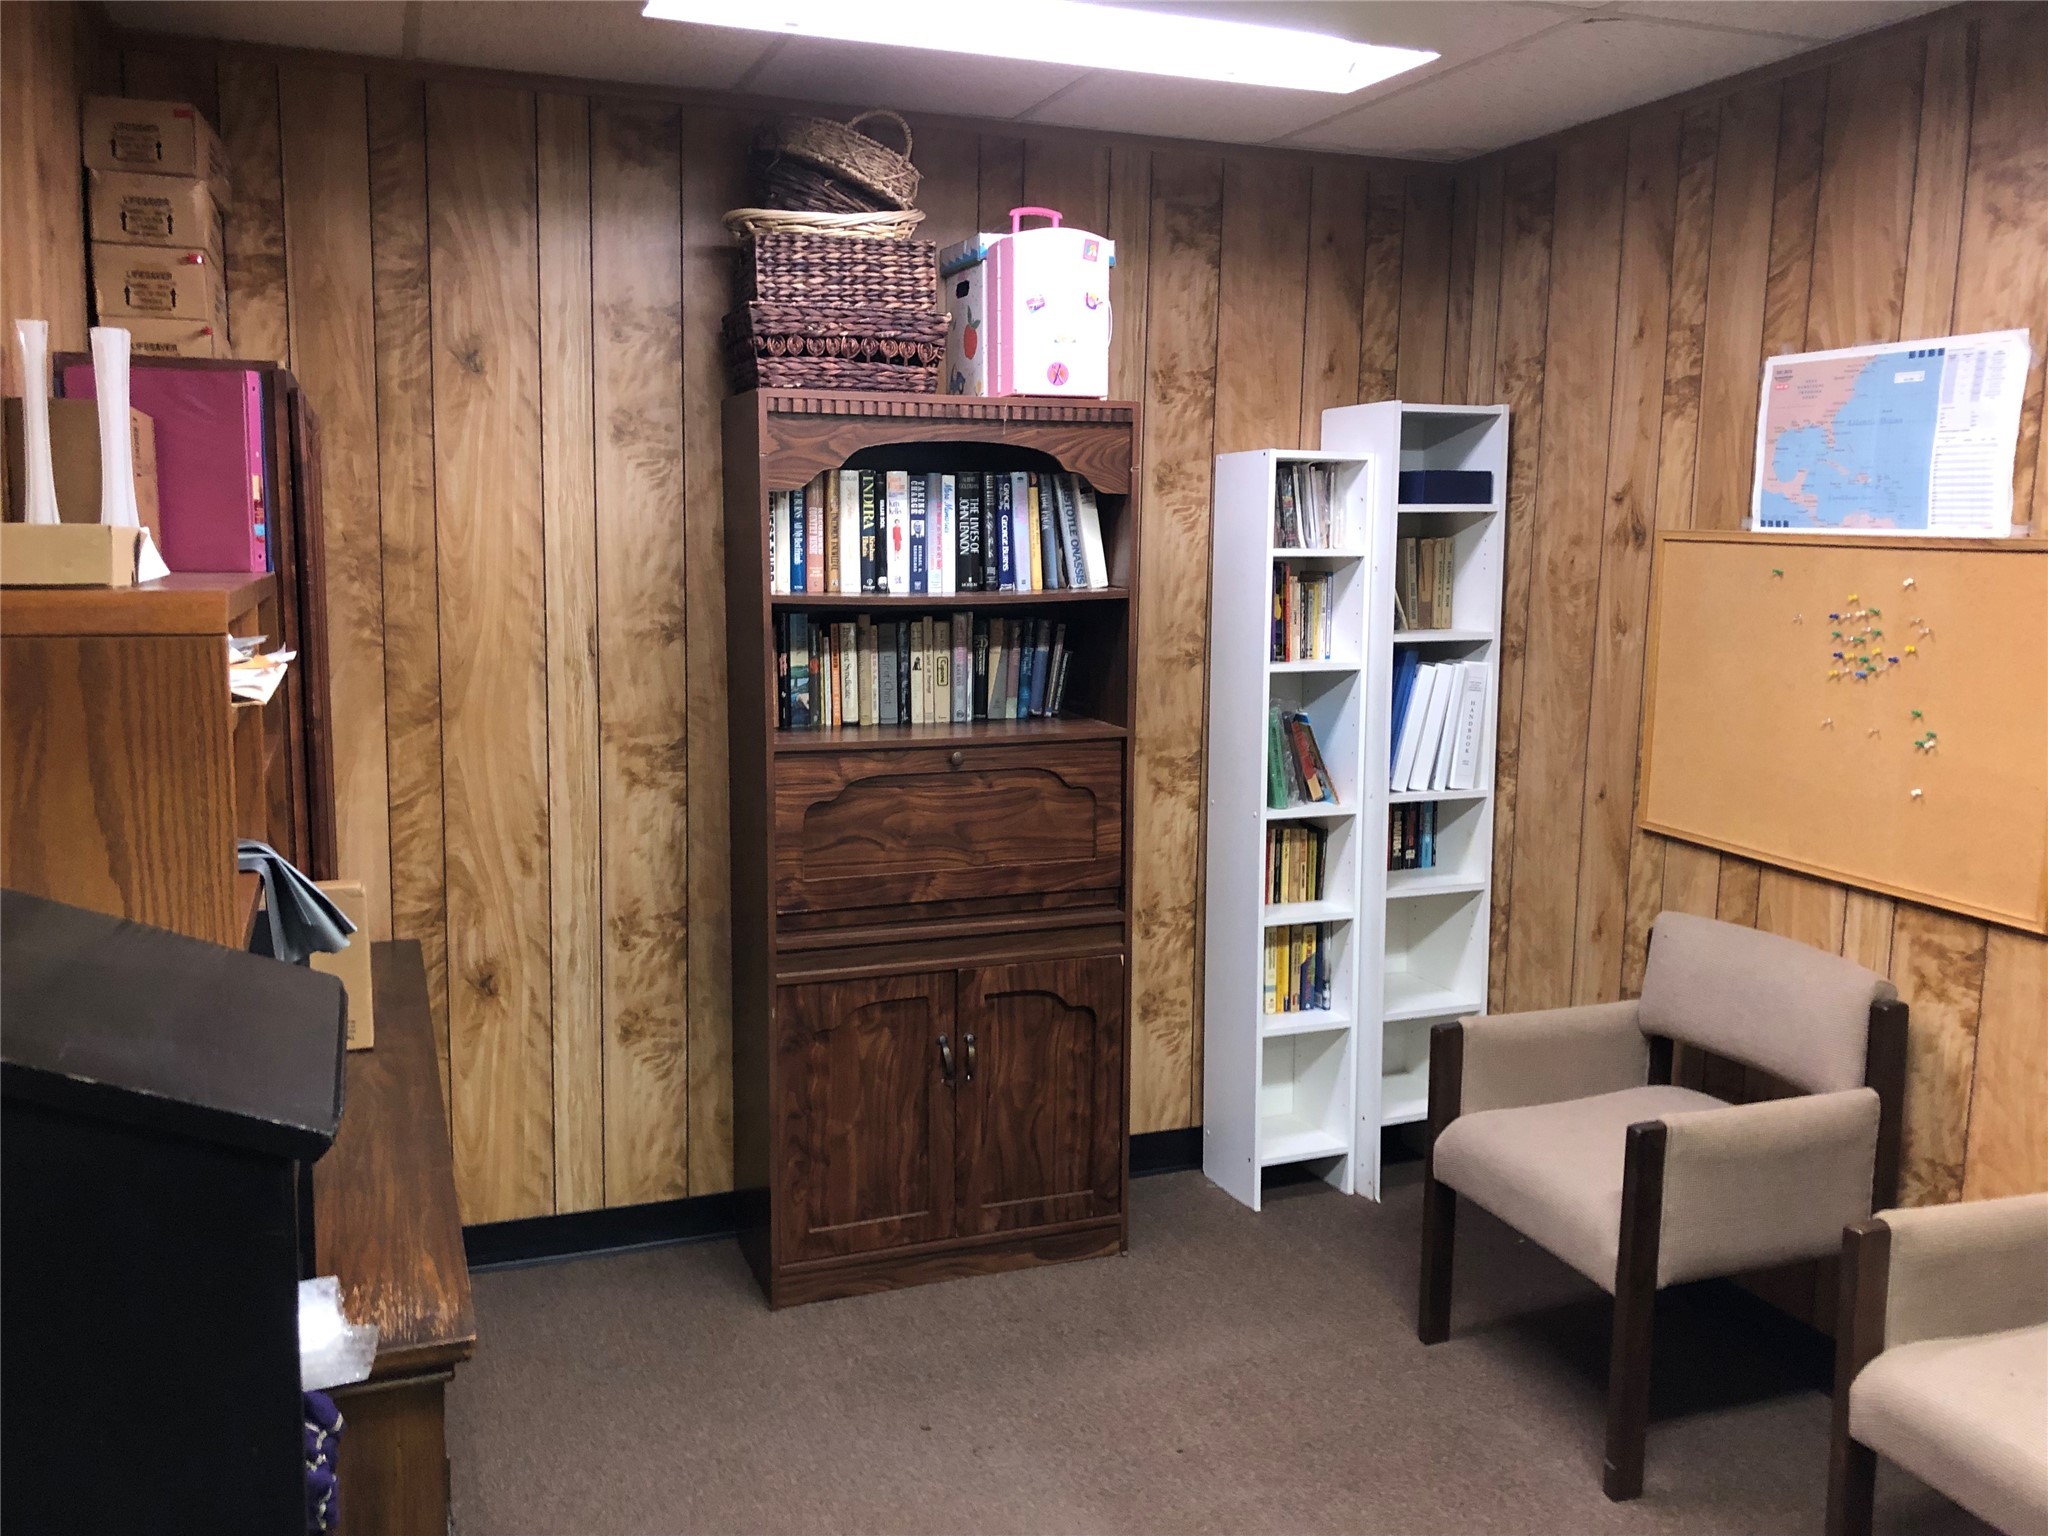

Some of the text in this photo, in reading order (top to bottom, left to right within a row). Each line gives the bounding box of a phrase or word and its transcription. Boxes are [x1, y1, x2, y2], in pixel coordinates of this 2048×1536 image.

[863, 476, 875, 530] INDIRA
[959, 497, 969, 555] JOHN LENNON
[970, 498, 979, 554] THE LIVES OF
[1070, 539, 1086, 585] ONASSIS
[937, 660, 946, 683] Capone
[1465, 700, 1476, 754] HANDBOOK
